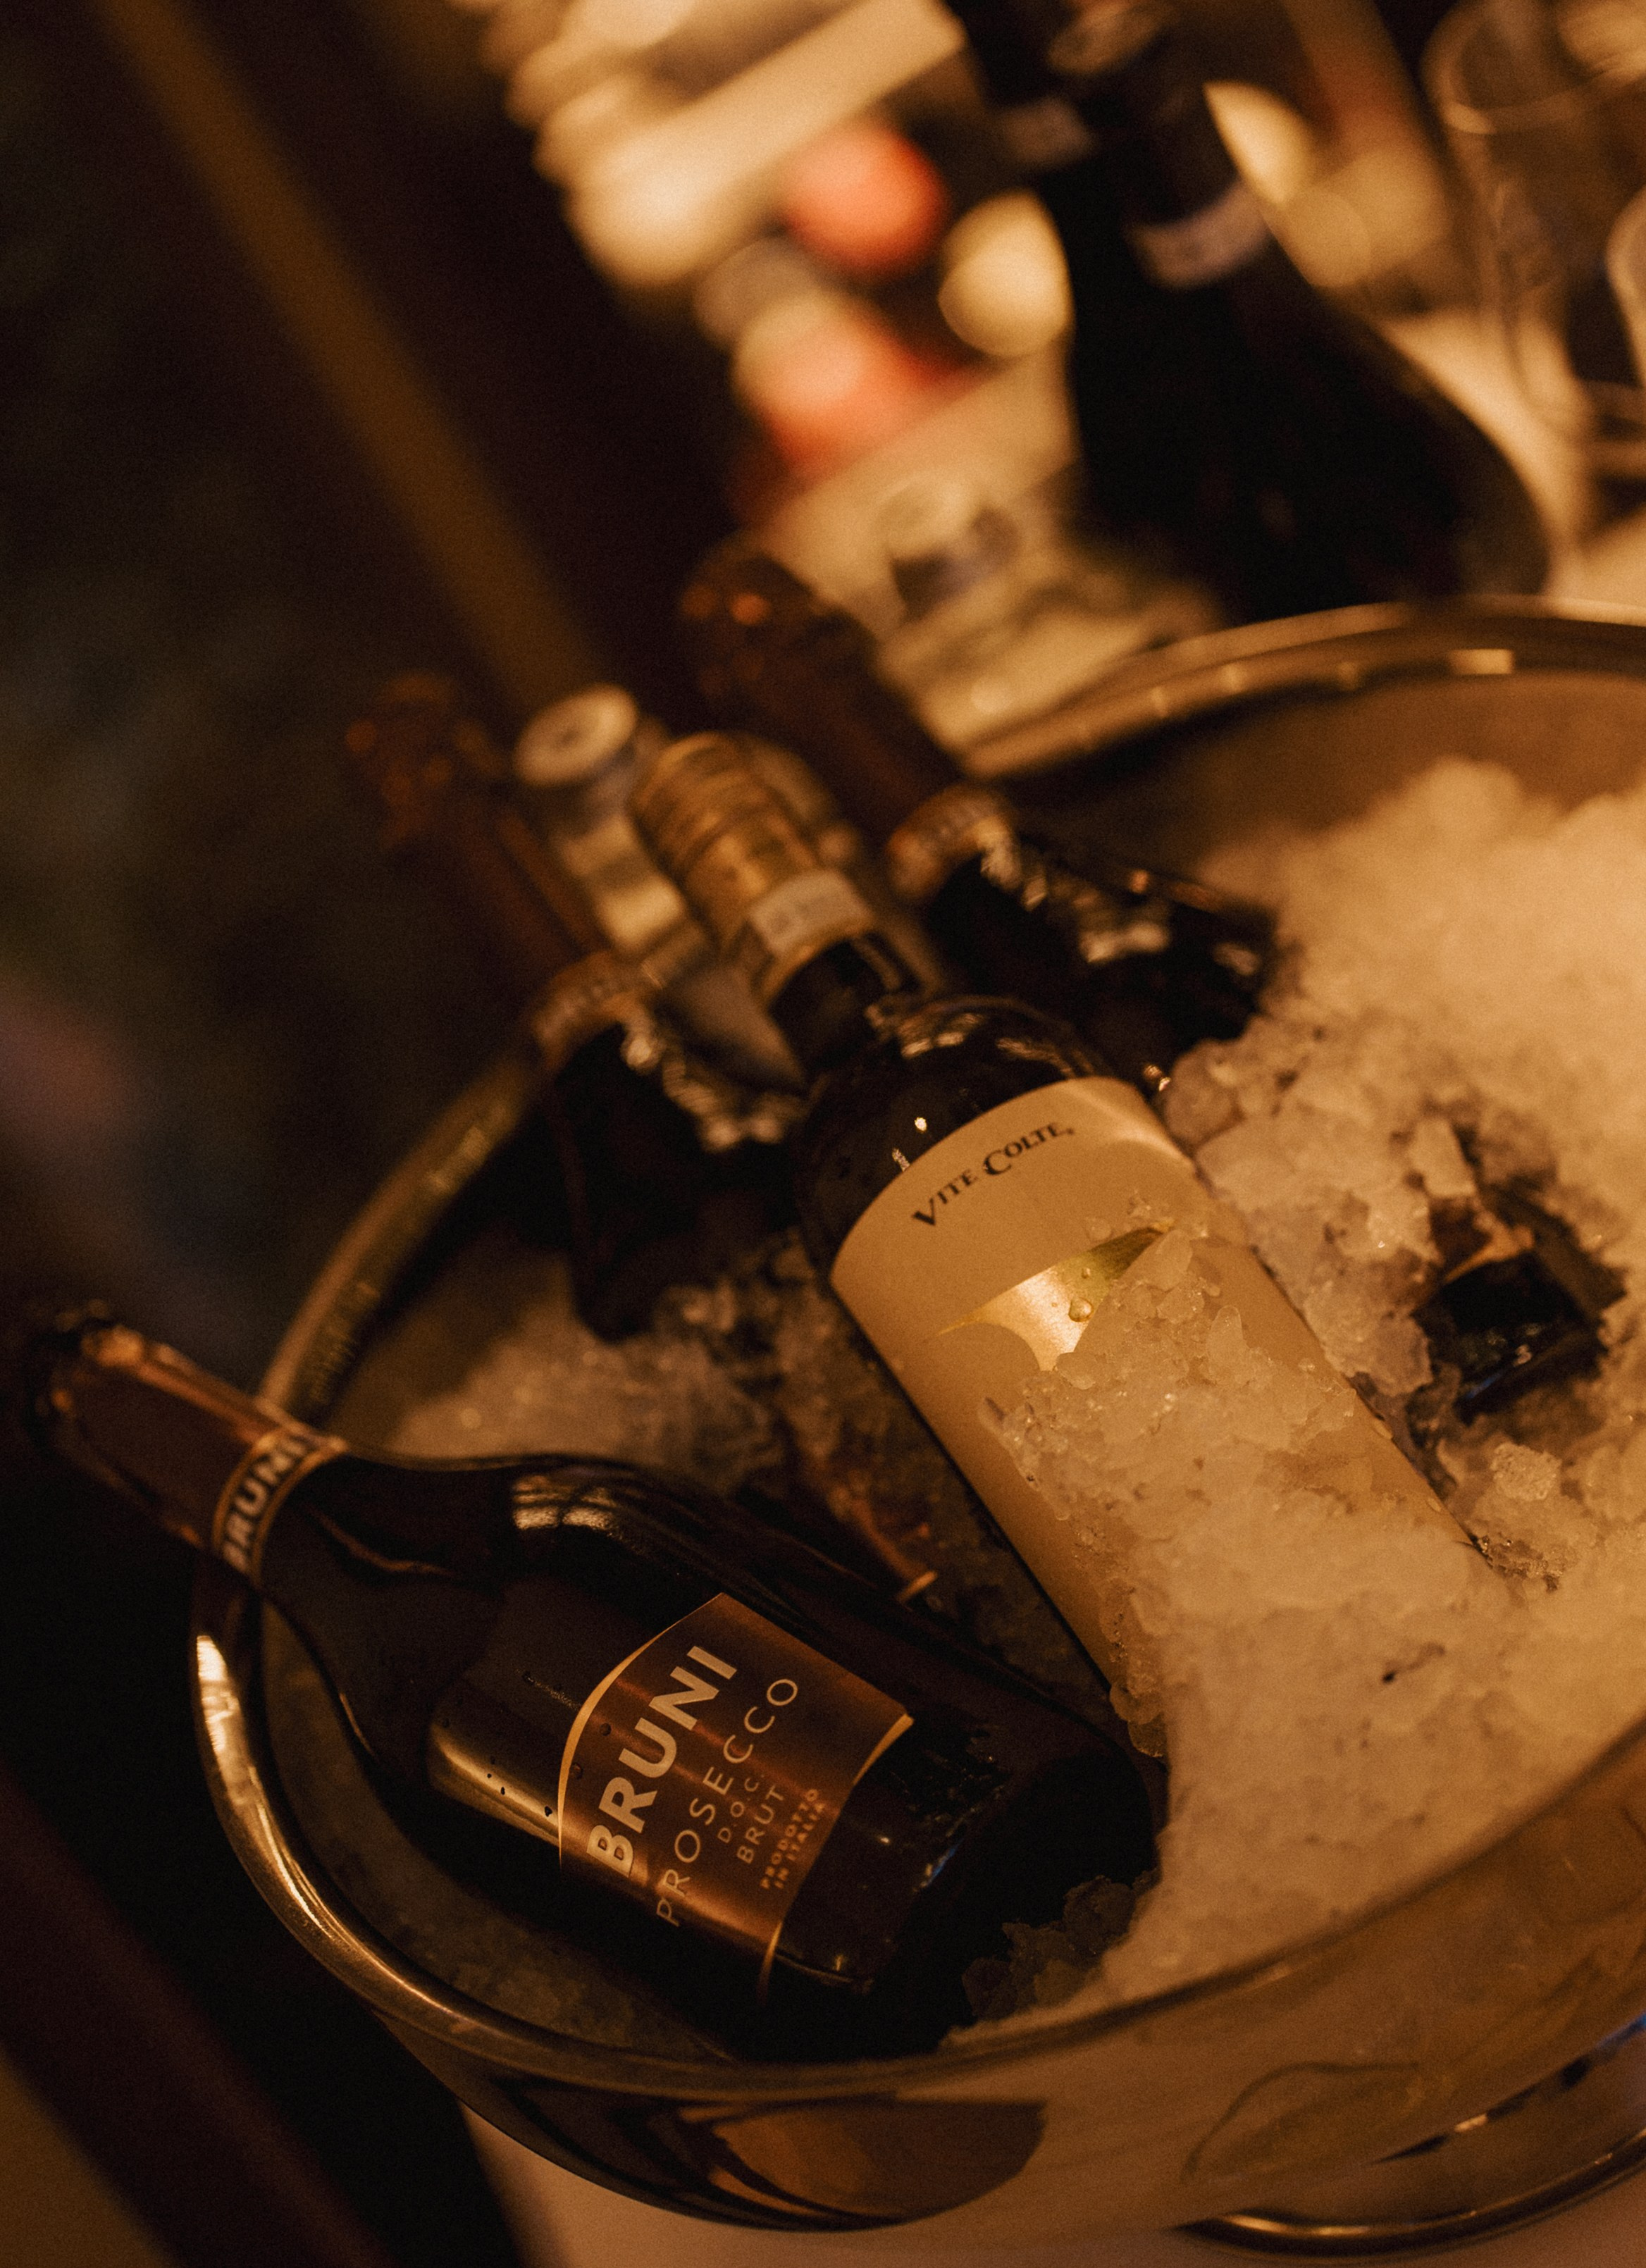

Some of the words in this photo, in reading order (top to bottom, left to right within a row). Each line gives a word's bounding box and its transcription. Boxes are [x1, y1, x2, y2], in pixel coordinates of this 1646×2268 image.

[911, 1169, 977, 1226] VITE
[586, 1645, 738, 1878] BRUNI
[655, 1678, 798, 1927] PROSECCO
[737, 1787, 785, 1864] BRUT
[761, 1788, 819, 1890] PRODOTTO
[774, 1868, 790, 1889] IN
[787, 1801, 825, 1861] ITALIA
